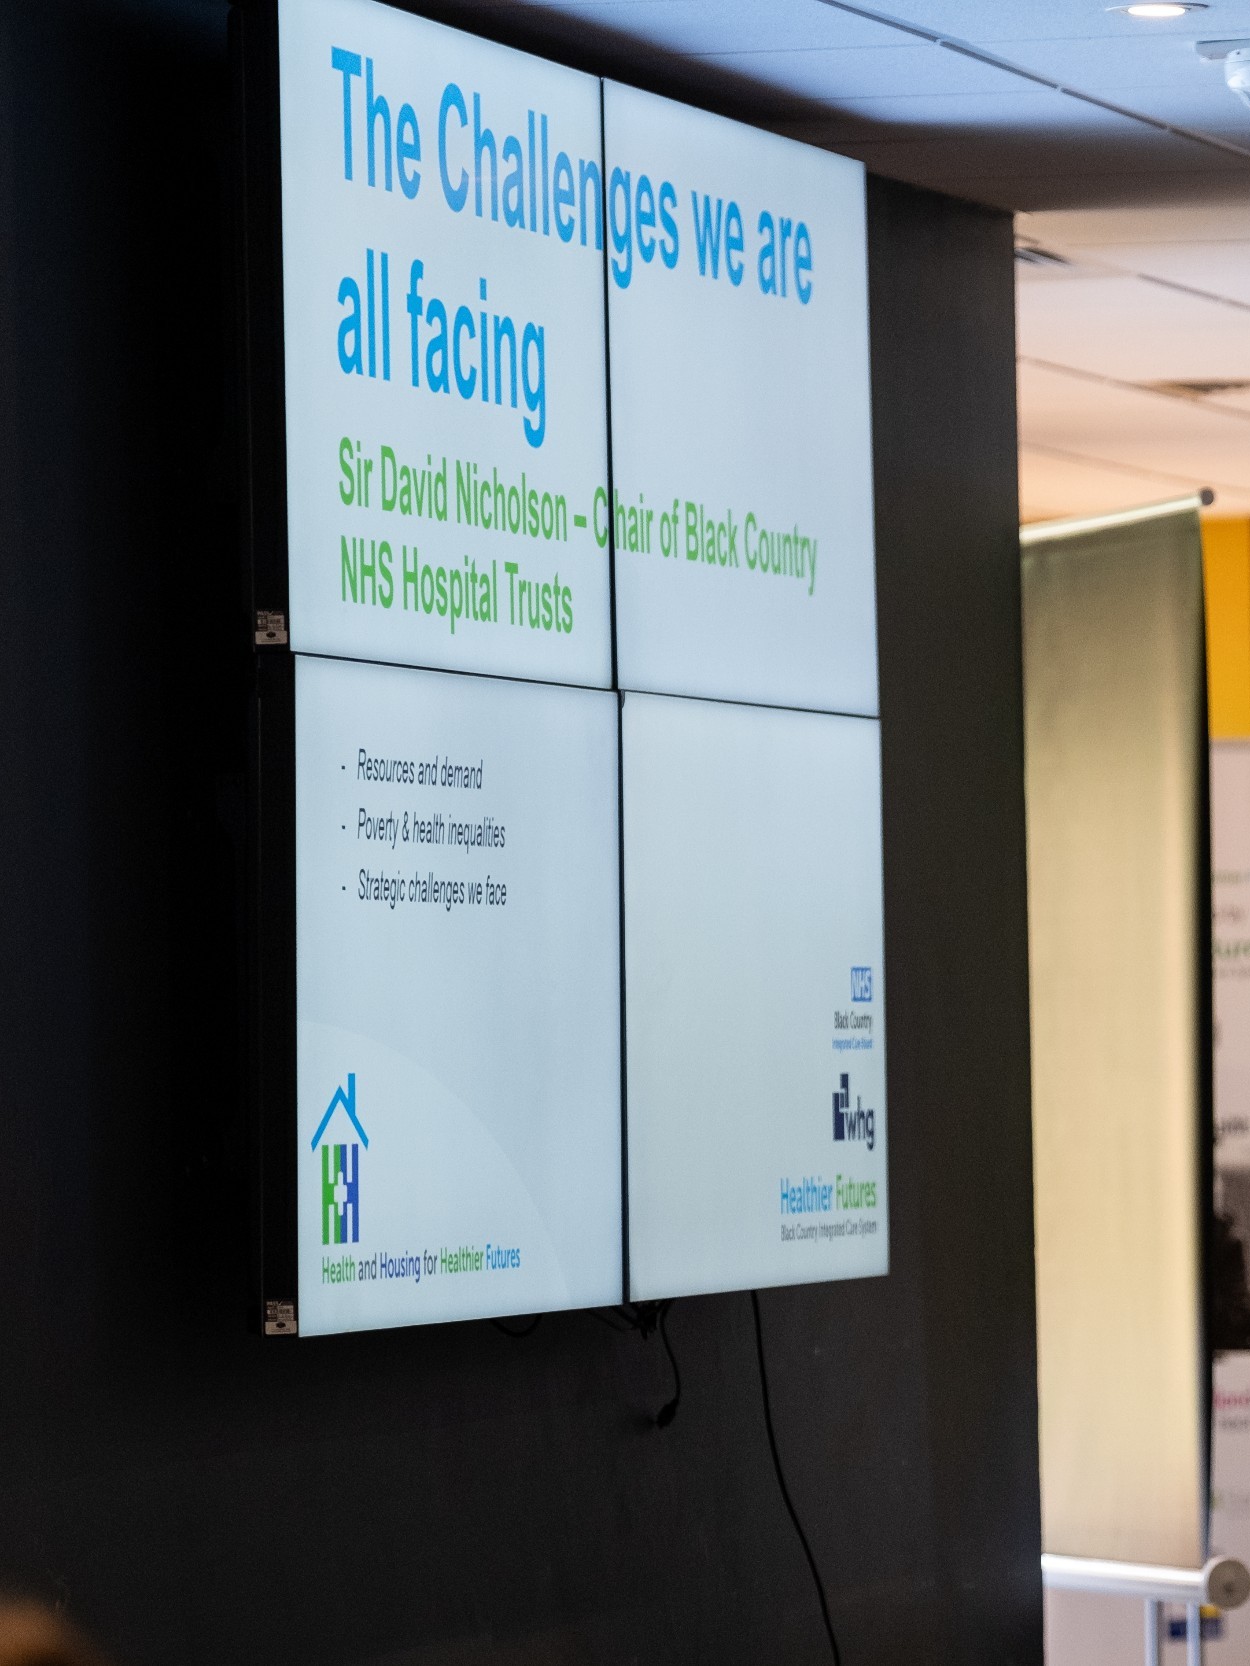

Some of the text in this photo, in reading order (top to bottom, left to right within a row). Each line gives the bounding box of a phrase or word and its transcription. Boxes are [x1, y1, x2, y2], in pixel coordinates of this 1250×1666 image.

[331, 46, 814, 305] The Challenges we are
[337, 247, 546, 449] all facing
[338, 436, 373, 508] Sir
[381, 445, 448, 522] David
[455, 459, 568, 542] Nicholson
[593, 486, 653, 555] Chair
[659, 496, 680, 559] of
[685, 501, 739, 569] Black
[744, 512, 818, 597] Country
[340, 535, 574, 635] NHS Hospital Trusts
[357, 748, 483, 790] Resources and demand
[357, 807, 506, 854] Poverty & health inequalities
[357, 868, 507, 912] Strategic challenges we face
[851, 967, 872, 1001] NHS
[834, 1010, 873, 1034] Black Country
[844, 1095, 875, 1151] whg
[781, 1173, 876, 1214] Healthier Futures
[781, 1224, 796, 1242] Black
[796, 1223, 818, 1243] Country
[819, 1221, 845, 1242] Integrated
[322, 1243, 520, 1285] Health and Housing for Healthier Futures
